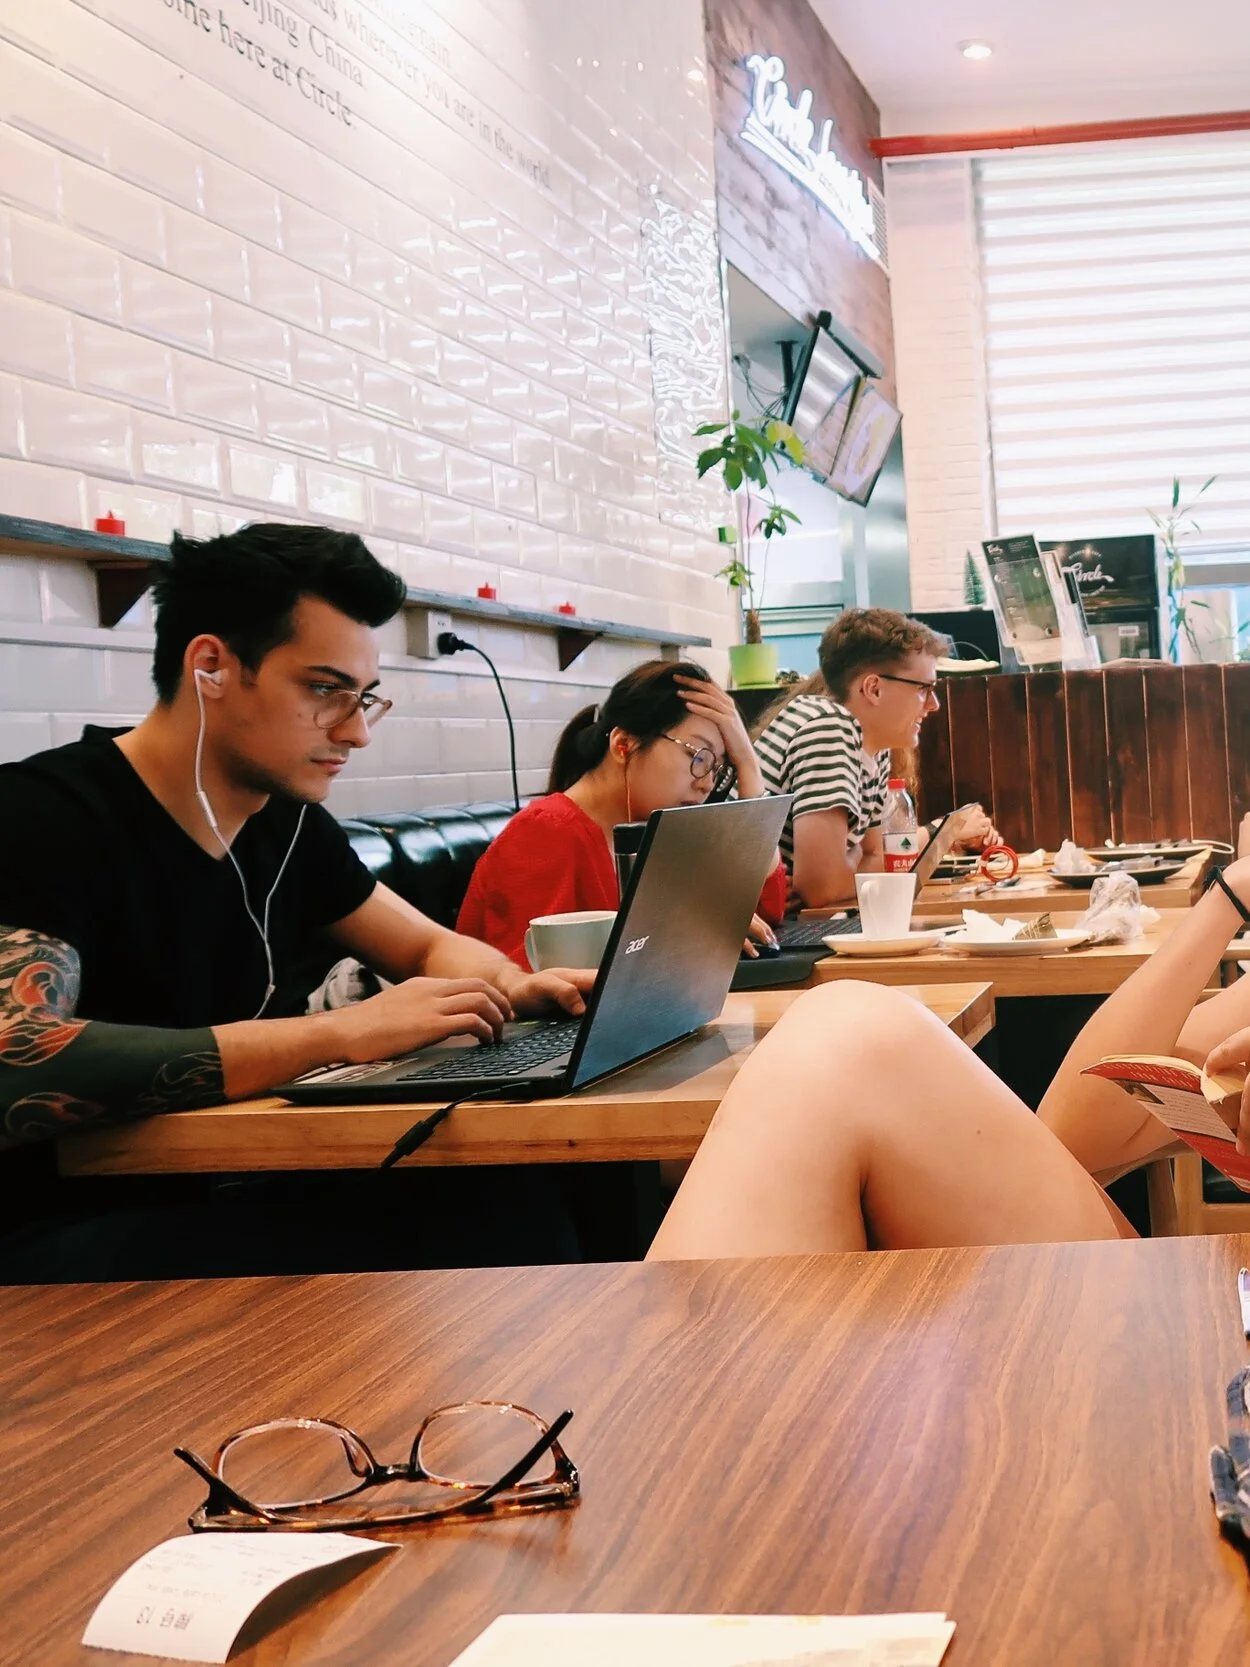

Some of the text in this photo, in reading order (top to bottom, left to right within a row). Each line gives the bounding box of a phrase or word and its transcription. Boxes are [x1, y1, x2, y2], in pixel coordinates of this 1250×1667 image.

[218, 10, 266, 69] here
[272, 56, 292, 86] at
[422, 72, 449, 109] you
[453, 98, 474, 128] are
[478, 112, 492, 143] in
[494, 127, 514, 160] the
[625, 935, 650, 955] acer
